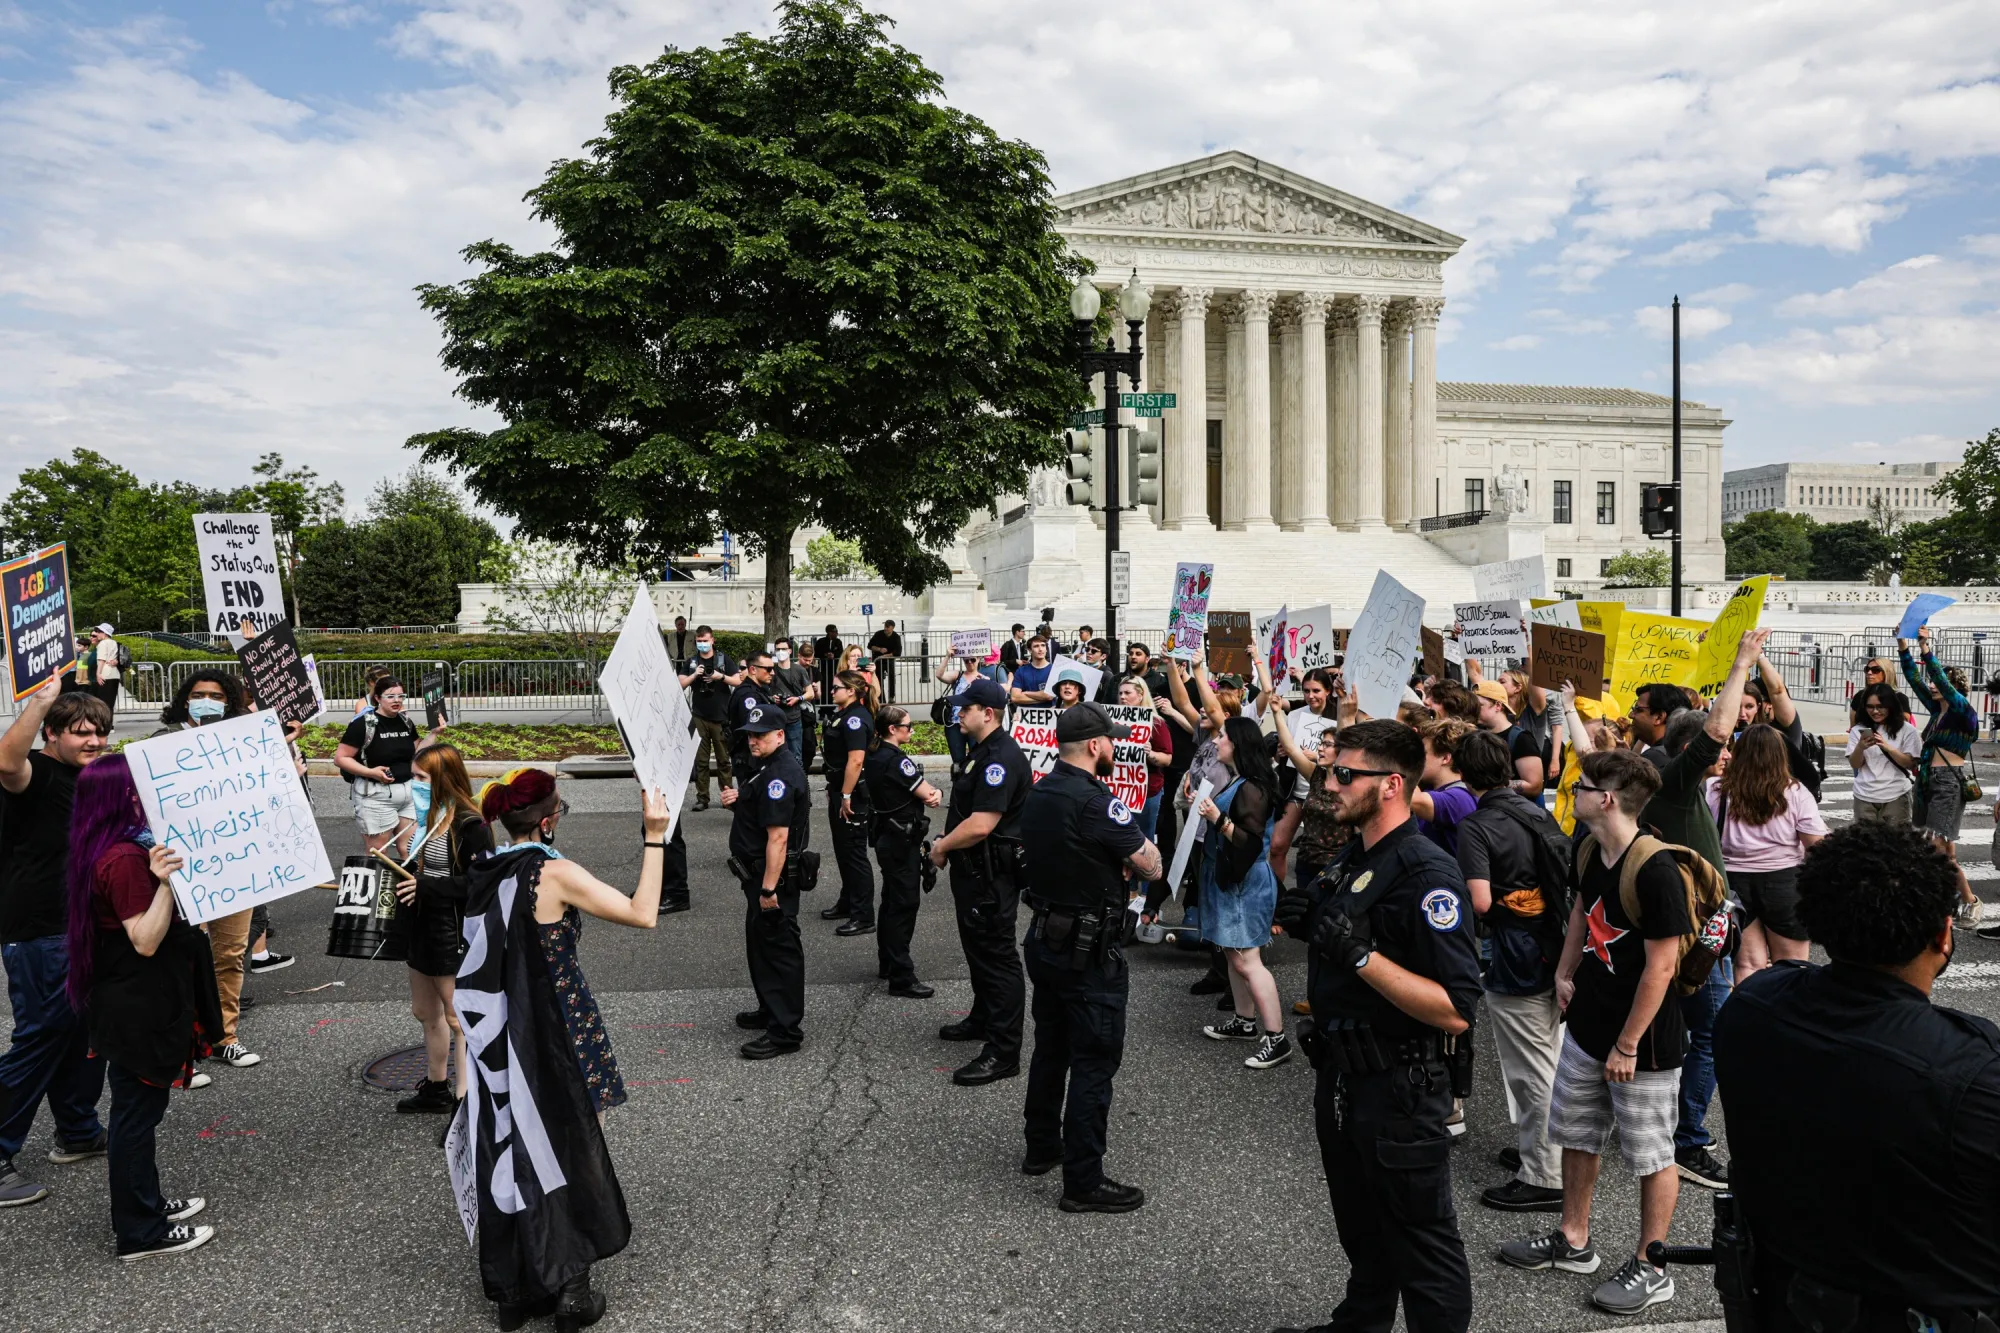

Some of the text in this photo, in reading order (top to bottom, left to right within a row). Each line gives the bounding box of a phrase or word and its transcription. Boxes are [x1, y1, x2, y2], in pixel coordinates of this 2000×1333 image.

[1191, 255, 1238, 267] JUSTICE
[1243, 257, 1282, 269] UNDER
[1288, 259, 1311, 270] LAW
[1123, 394, 1163, 407] FIRST
[1136, 408, 1160, 417] UNIT
[1072, 413, 1097, 425] RYLAND
[203, 519, 260, 545] Challenge
[226, 539, 243, 549] the
[211, 552, 275, 574] Status Quo
[19, 567, 55, 602] LGBT+
[221, 580, 264, 608] END
[12, 585, 65, 630] Democrat
[1207, 614, 1249, 628] ABORTION
[18, 613, 66, 655] standing
[1549, 629, 1588, 654] KEEP
[27, 638, 64, 677] for life
[245, 635, 276, 665] NO ONE
[271, 643, 290, 660] have
[273, 662, 280, 673] of
[280, 648, 298, 668] dead
[1536, 647, 1598, 674] ABORTION
[1628, 641, 1690, 660] RIGHTS
[258, 670, 290, 698] Children
[1640, 663, 1673, 683] ARE
[264, 676, 298, 705] because NO
[271, 690, 297, 712] hildren
[1020, 709, 1053, 725] KEEP
[1118, 707, 1137, 721] ARE
[1138, 708, 1153, 722] NOT
[1013, 726, 1059, 748] ROSAR
[142, 728, 273, 781] Leftist
[1113, 745, 1145, 763] RE NOT
[155, 765, 270, 820] Feminist
[163, 804, 265, 853] Atheist
[178, 841, 261, 884] Vegan
[191, 864, 306, 918] Pro-Life
